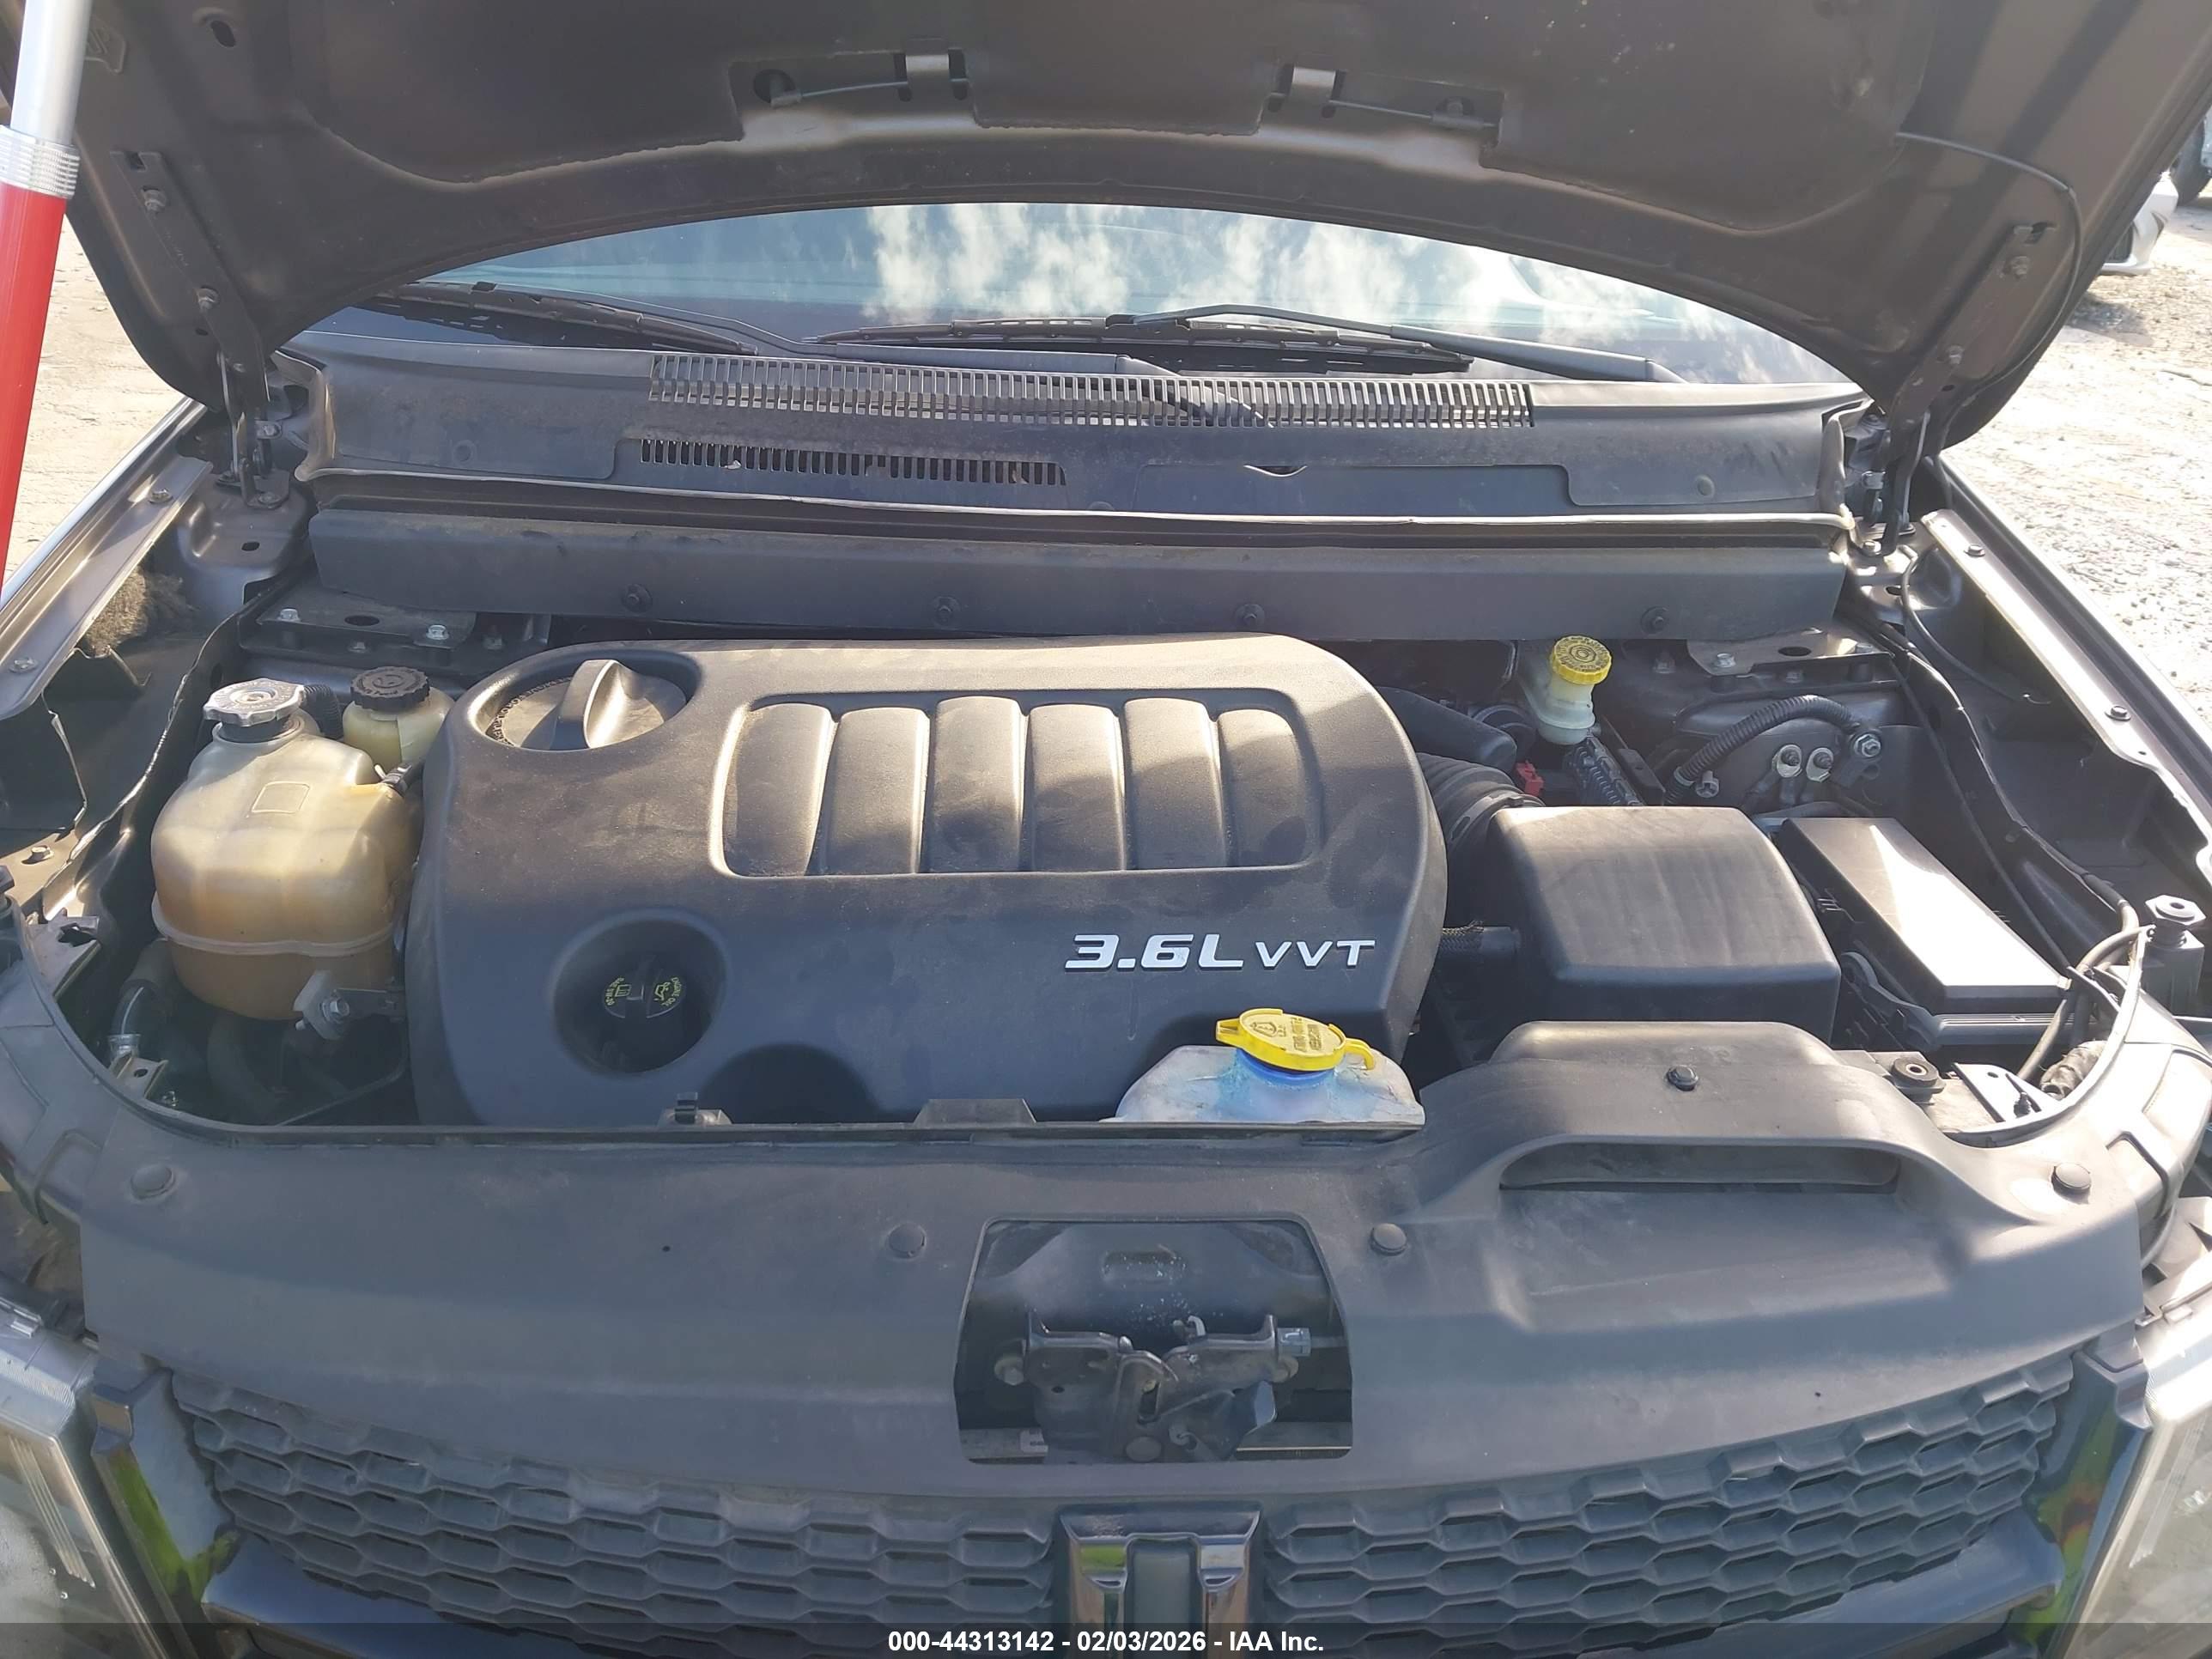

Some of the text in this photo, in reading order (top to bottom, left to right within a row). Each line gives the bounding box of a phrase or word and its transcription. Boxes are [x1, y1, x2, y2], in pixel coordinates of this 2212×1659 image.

[1065, 933, 1376, 971] 3.6L VVT
[660, 997, 676, 1007] OIL
